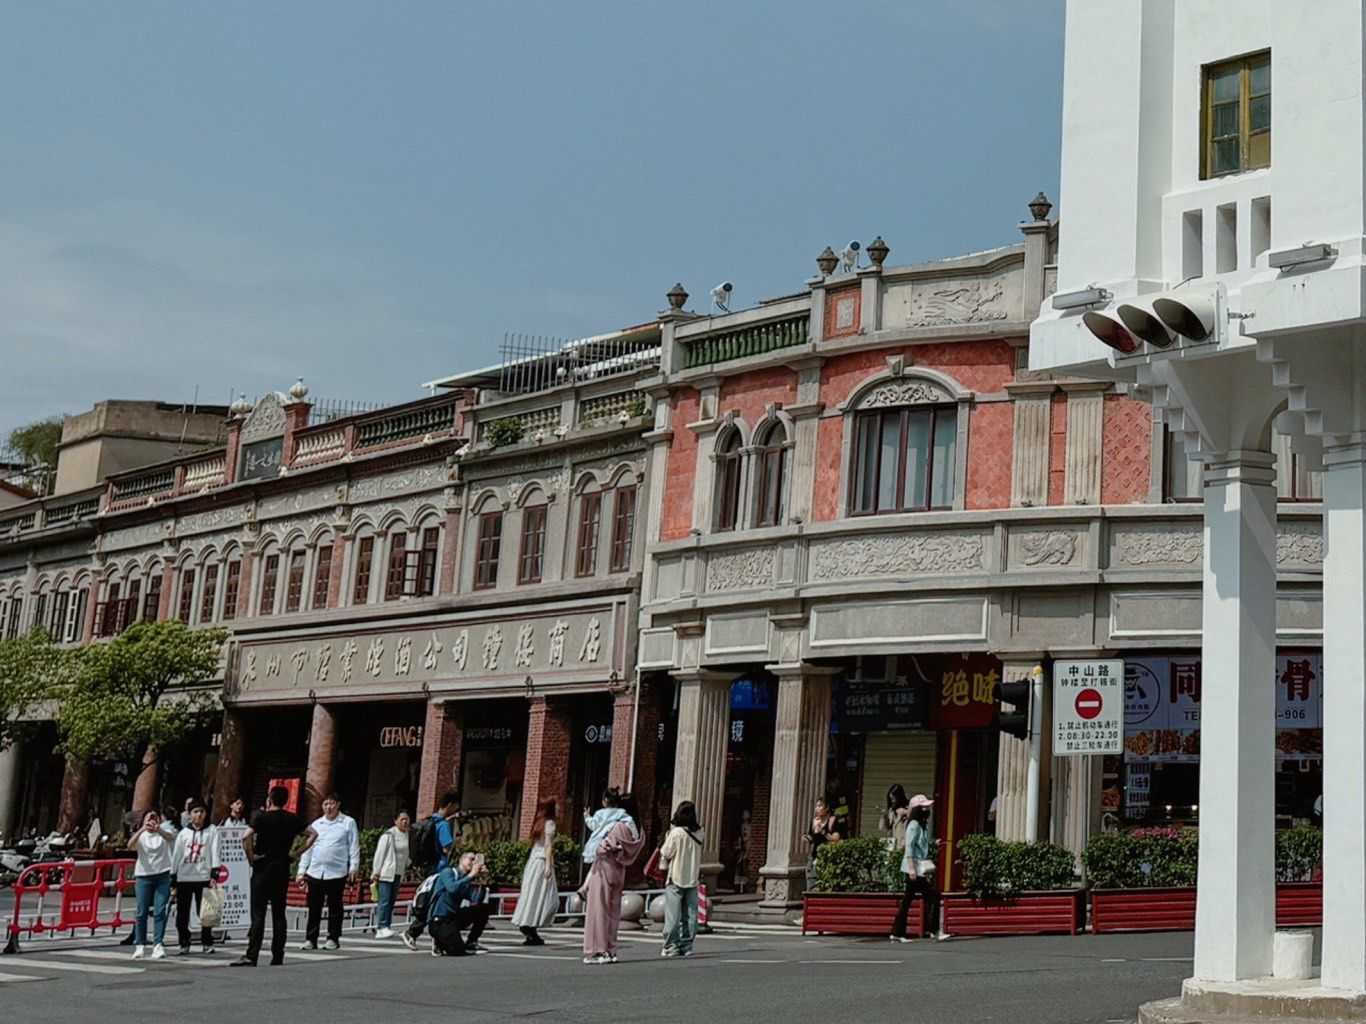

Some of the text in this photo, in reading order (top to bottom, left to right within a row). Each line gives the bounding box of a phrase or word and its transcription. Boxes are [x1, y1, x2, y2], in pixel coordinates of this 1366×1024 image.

[1069, 665, 1109, 677] 中山路
[1281, 658, 1315, 701] 骨
[1183, 710, 1201, 721] TE
